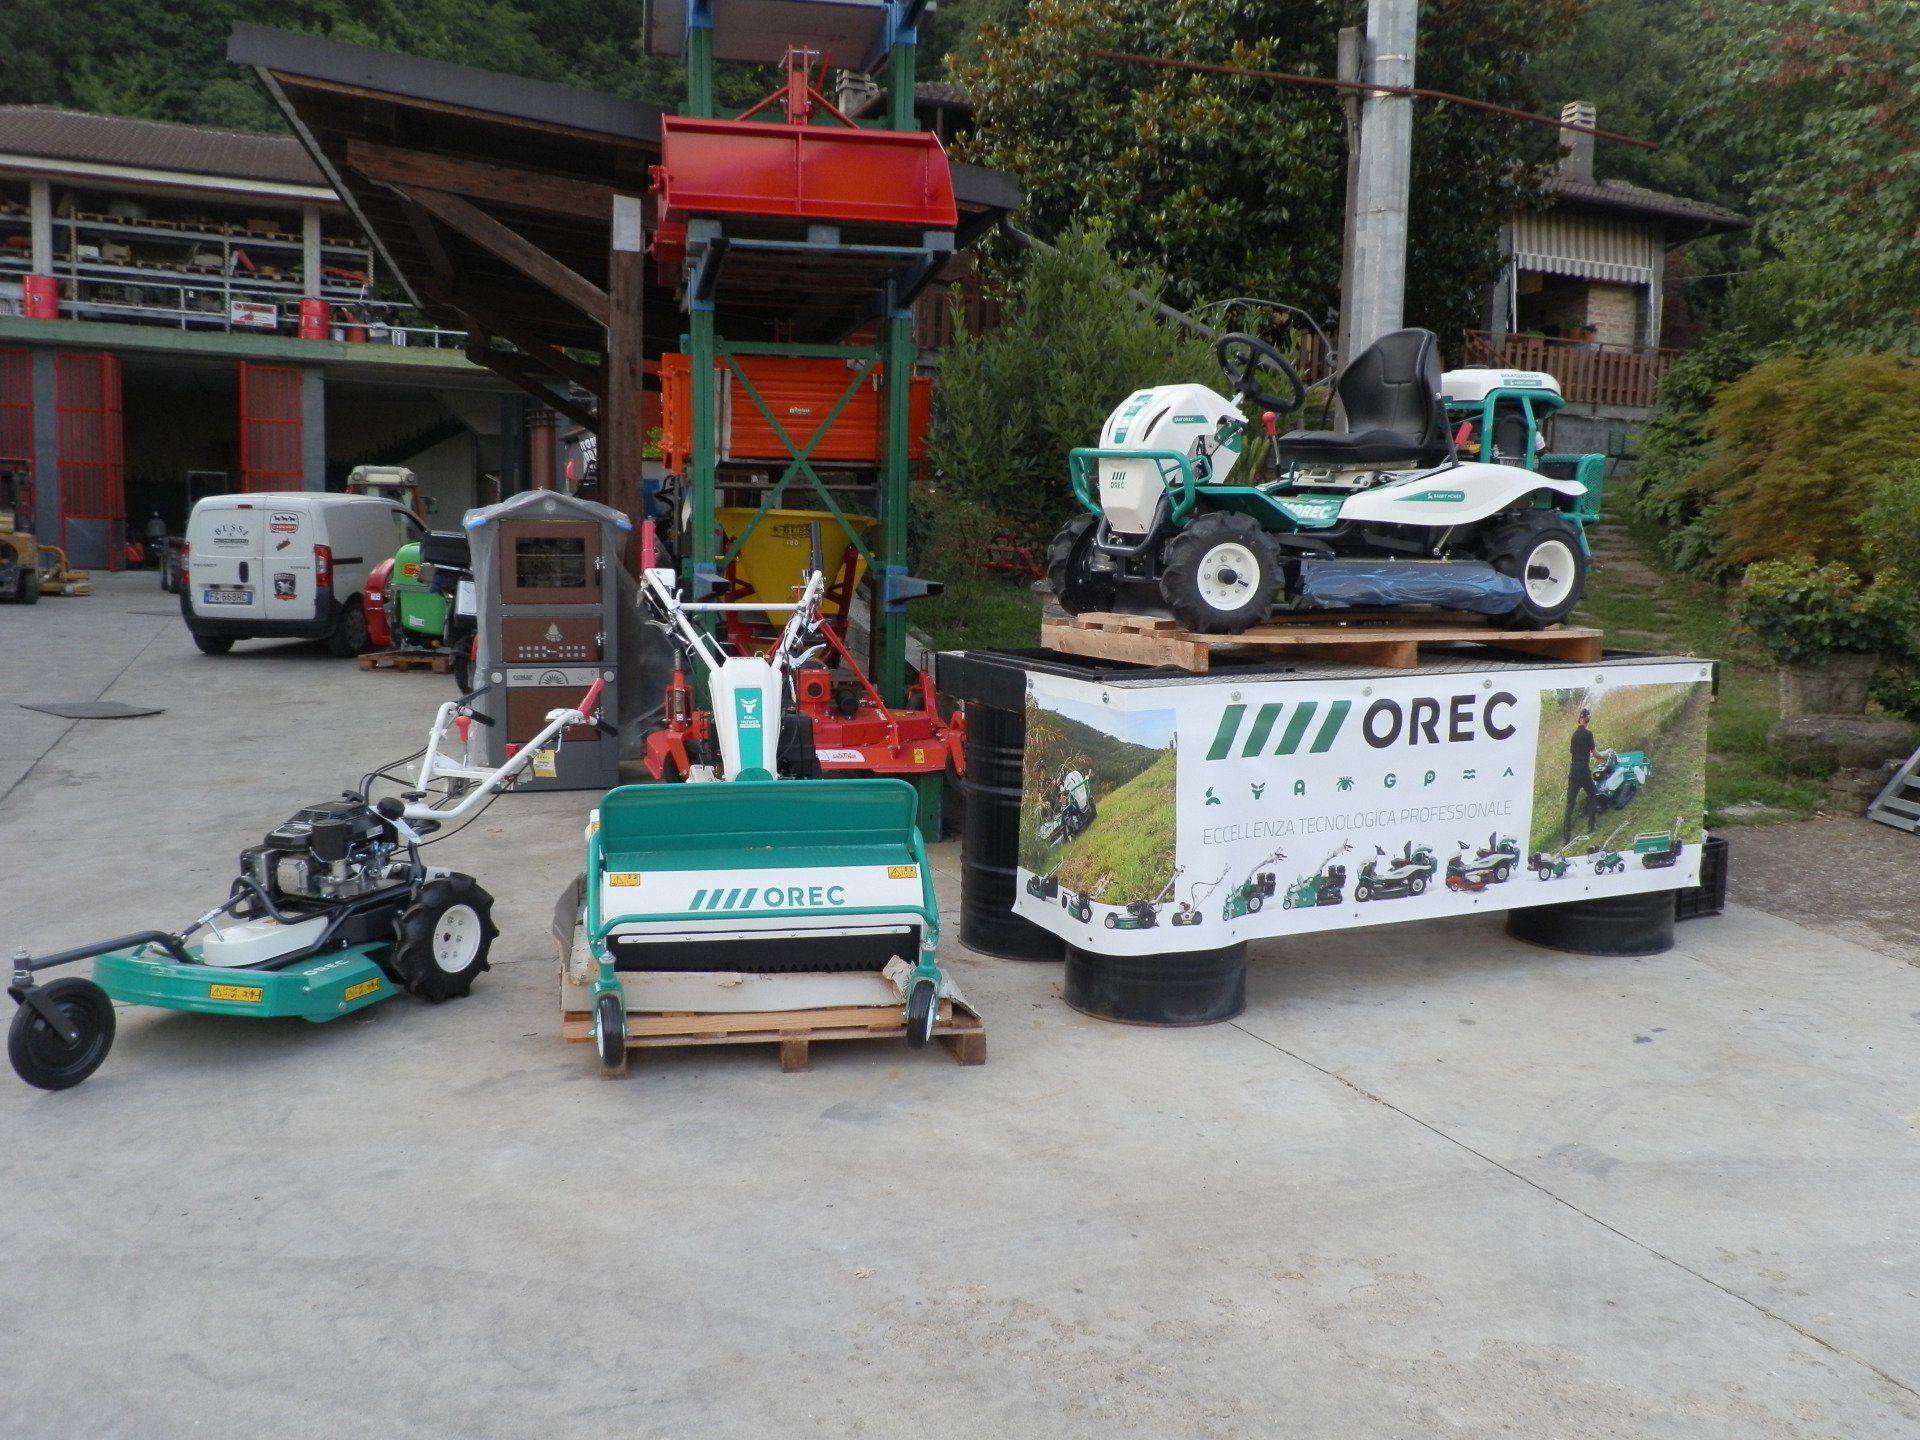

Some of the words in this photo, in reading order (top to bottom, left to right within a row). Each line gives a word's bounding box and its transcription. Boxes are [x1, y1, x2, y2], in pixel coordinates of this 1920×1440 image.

[1294, 504, 1332, 518] OREC
[1362, 691, 1518, 749] OREC
[1203, 820, 1295, 845] ECCELLENZA
[1299, 808, 1397, 836] TECNOLOGICA
[1400, 799, 1513, 825] PROFESSIONALE
[763, 885, 846, 908] OREC
[302, 959, 349, 976] OREC
